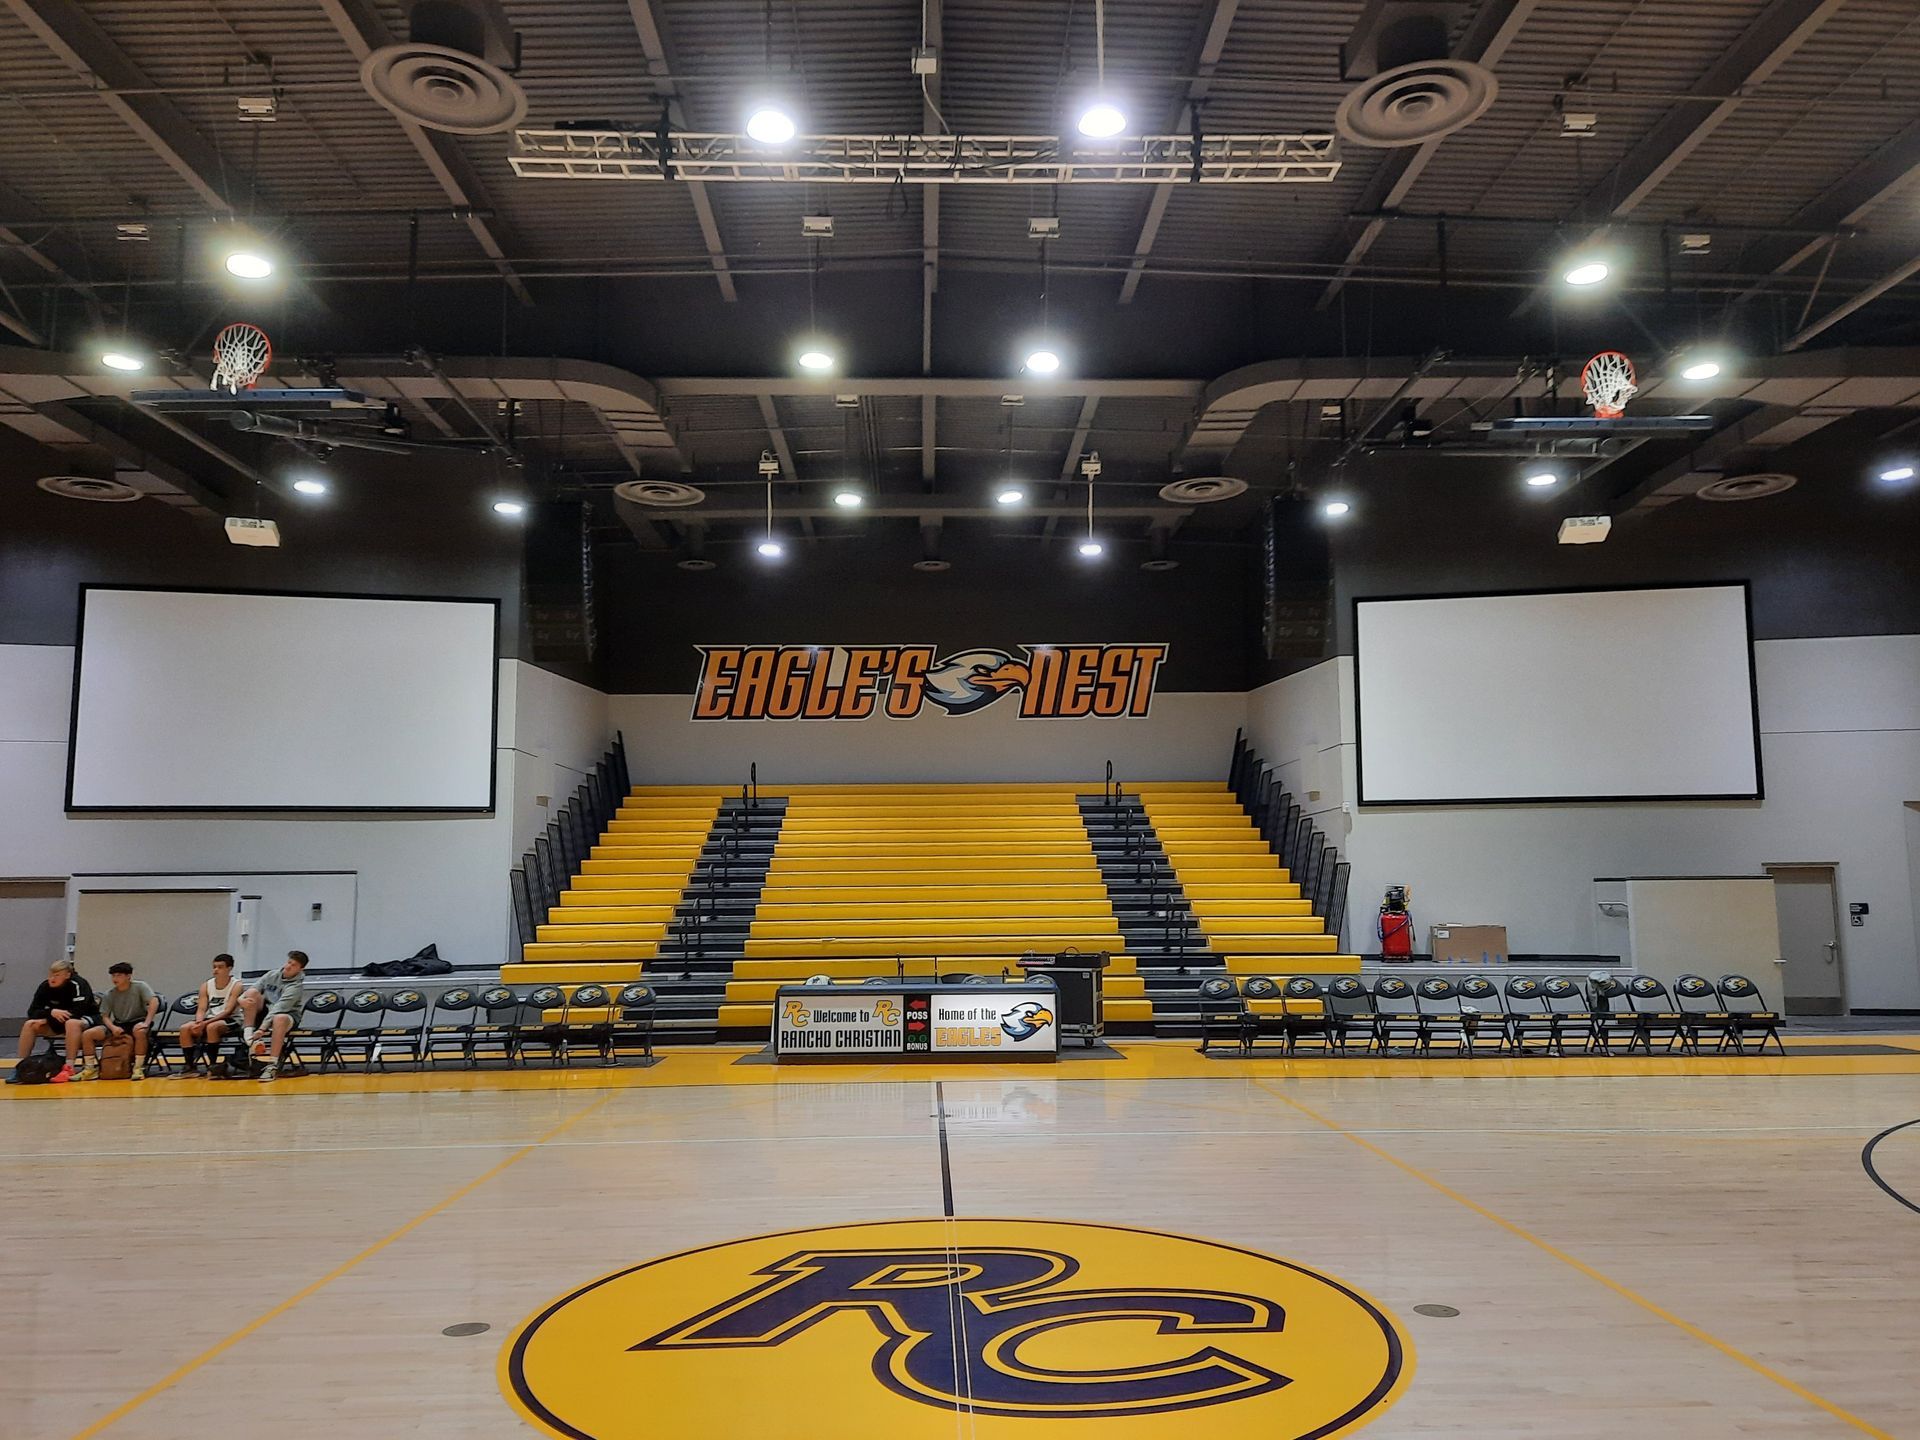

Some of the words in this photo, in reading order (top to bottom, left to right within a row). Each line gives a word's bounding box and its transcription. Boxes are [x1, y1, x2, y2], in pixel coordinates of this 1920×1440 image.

[690, 644, 937, 721] EAGLE'S
[1016, 643, 1170, 720] NEST
[782, 1001, 811, 1027] RC
[813, 1010, 857, 1023] Welcome
[859, 1009, 870, 1023] to
[872, 1000, 901, 1026] RC
[906, 1011, 928, 1020] POSS
[938, 1008, 965, 1021] Home
[967, 1008, 977, 1020] of
[981, 1008, 997, 1020] the
[781, 1030, 831, 1048] RANCHO
[835, 1029, 901, 1048] CHRISTIAN
[935, 1027, 1002, 1047] EAGLES
[624, 1249, 1294, 1418] RC
